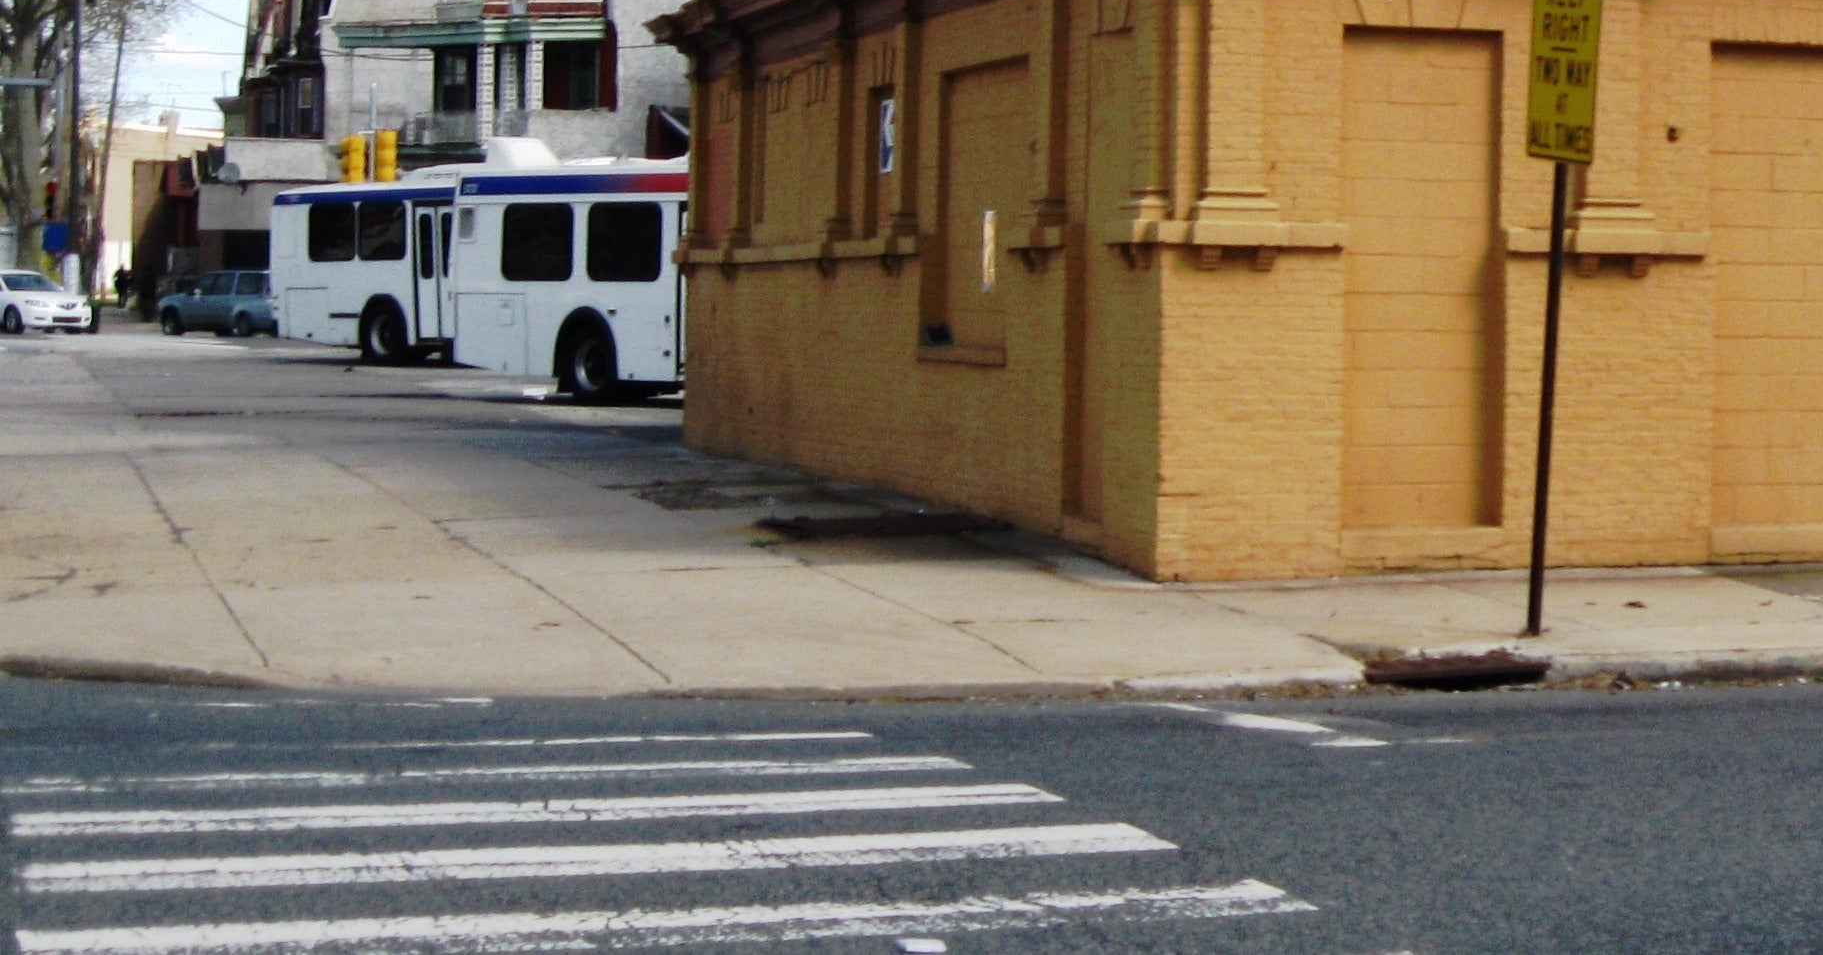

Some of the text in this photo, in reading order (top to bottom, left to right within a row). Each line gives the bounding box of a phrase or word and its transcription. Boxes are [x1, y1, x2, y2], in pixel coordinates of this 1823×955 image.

[1542, 12, 1590, 43] RIGHT
[1535, 55, 1593, 88] TWO WAY
[1530, 120, 1593, 154] ALL TIMES
